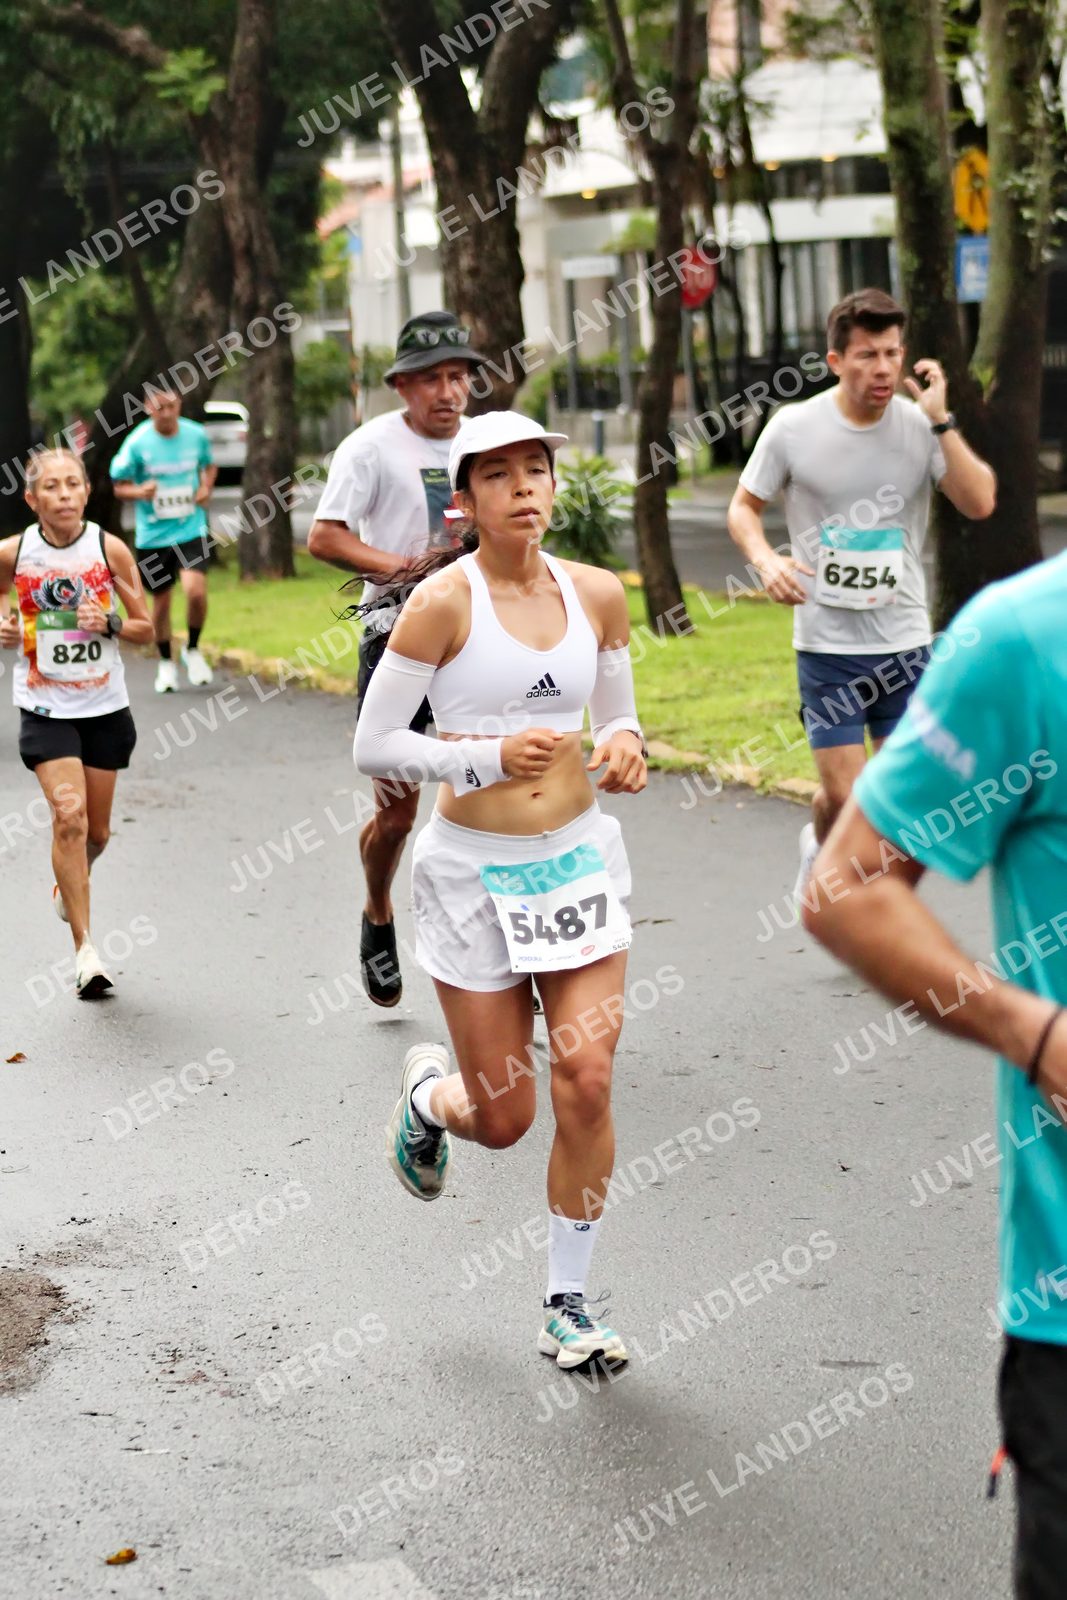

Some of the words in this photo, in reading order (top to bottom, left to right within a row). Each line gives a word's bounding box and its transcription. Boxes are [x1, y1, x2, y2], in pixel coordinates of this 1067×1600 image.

[824, 563, 897, 590] 6254
[52, 641, 102, 665] 820
[526, 688, 561, 698] adidas
[465, 767, 475, 785] NIKE
[508, 892, 608, 945] 5487
